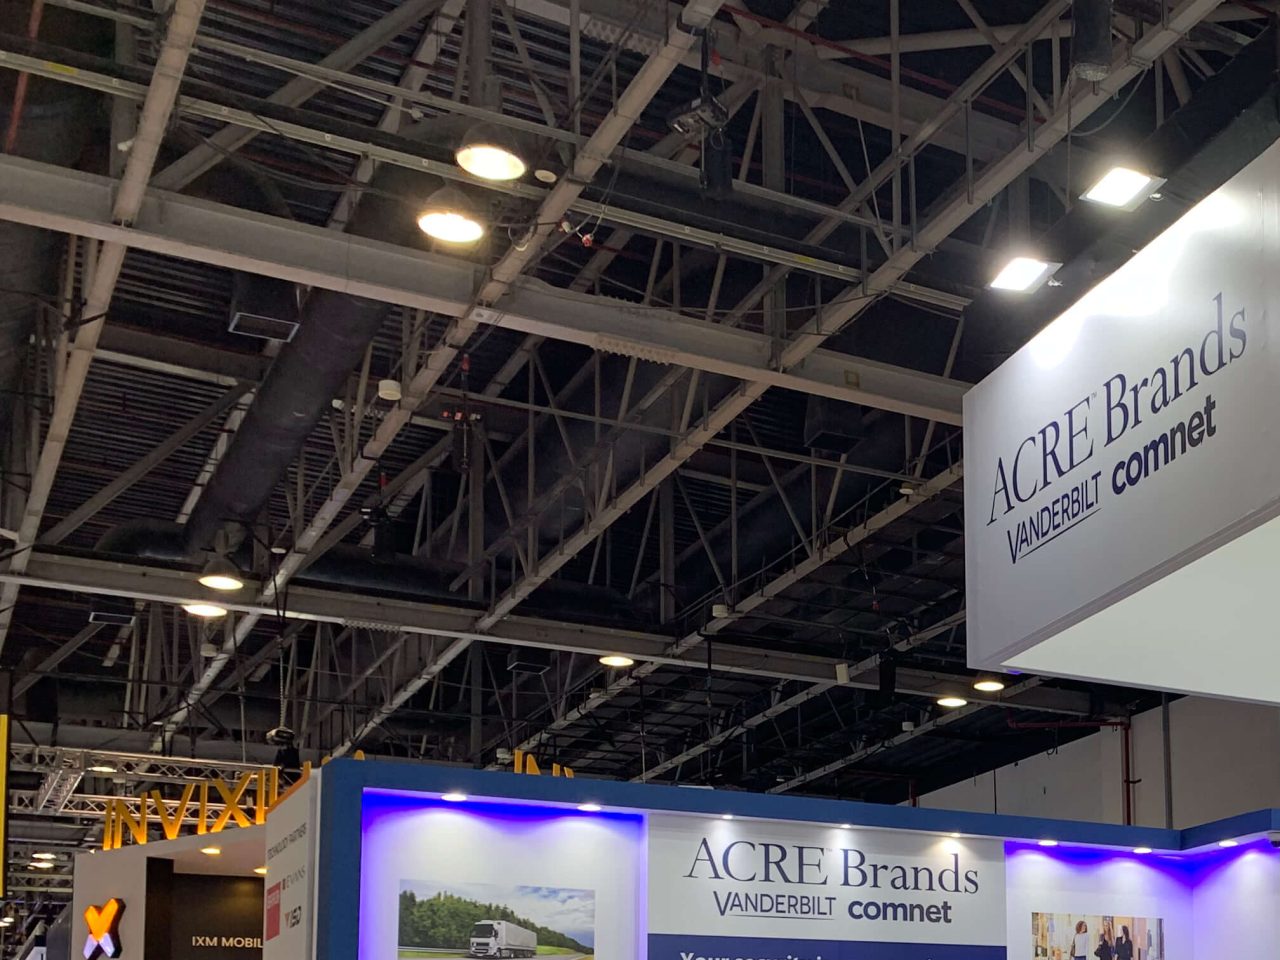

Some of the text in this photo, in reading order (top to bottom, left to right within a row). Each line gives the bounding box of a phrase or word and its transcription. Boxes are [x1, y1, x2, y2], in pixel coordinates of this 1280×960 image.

[987, 396, 1094, 526] ACRE
[1103, 292, 1247, 447] Brands
[1007, 394, 1216, 564] VANDERBILT comnet
[683, 837, 829, 885] ACRE
[840, 848, 979, 894] Brands
[713, 891, 952, 923] VANDERBILT comnet
[192, 936, 217, 947] IXM
